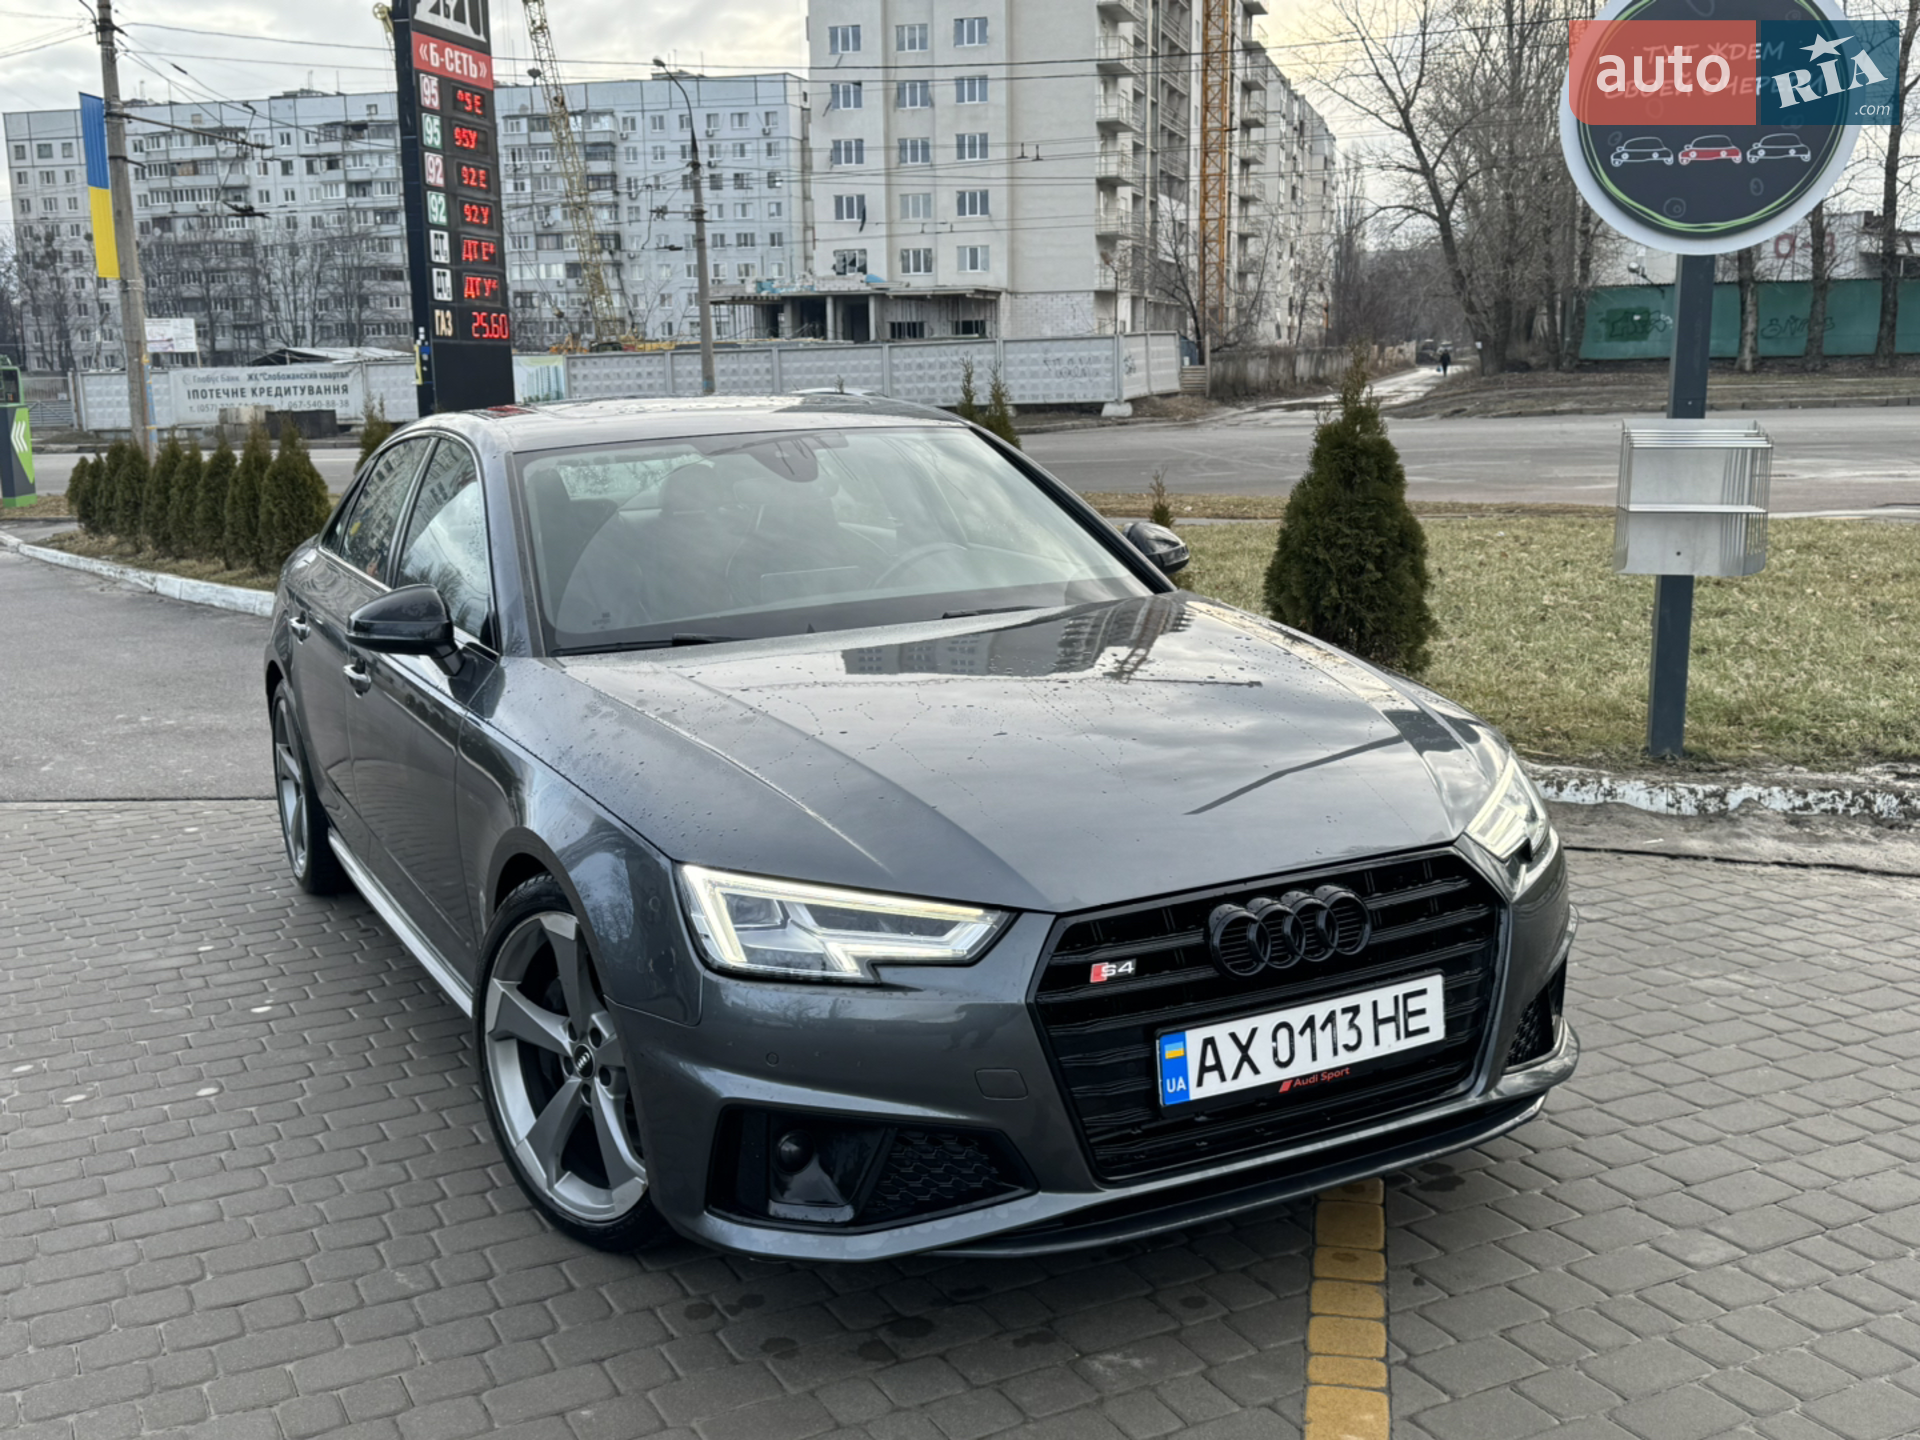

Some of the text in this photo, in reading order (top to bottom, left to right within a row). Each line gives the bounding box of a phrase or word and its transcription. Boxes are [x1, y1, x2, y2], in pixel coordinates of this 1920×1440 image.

[419, 42, 487, 79] «Б-СЕТЬ»
[423, 76, 439, 108] 95
[425, 115, 441, 146] 95
[427, 154, 445, 186] 92
[430, 194, 447, 224] 92
[434, 309, 453, 337] ГАЗ
[187, 384, 349, 400] ІПОТЕЧНЕ КРЕДИТУВАННЯ
[1101, 961, 1134, 976] S4
[1196, 988, 1430, 1088] AX 0113 HE
[1166, 1077, 1187, 1093] UA
[1293, 1067, 1350, 1088] Audi Sport
